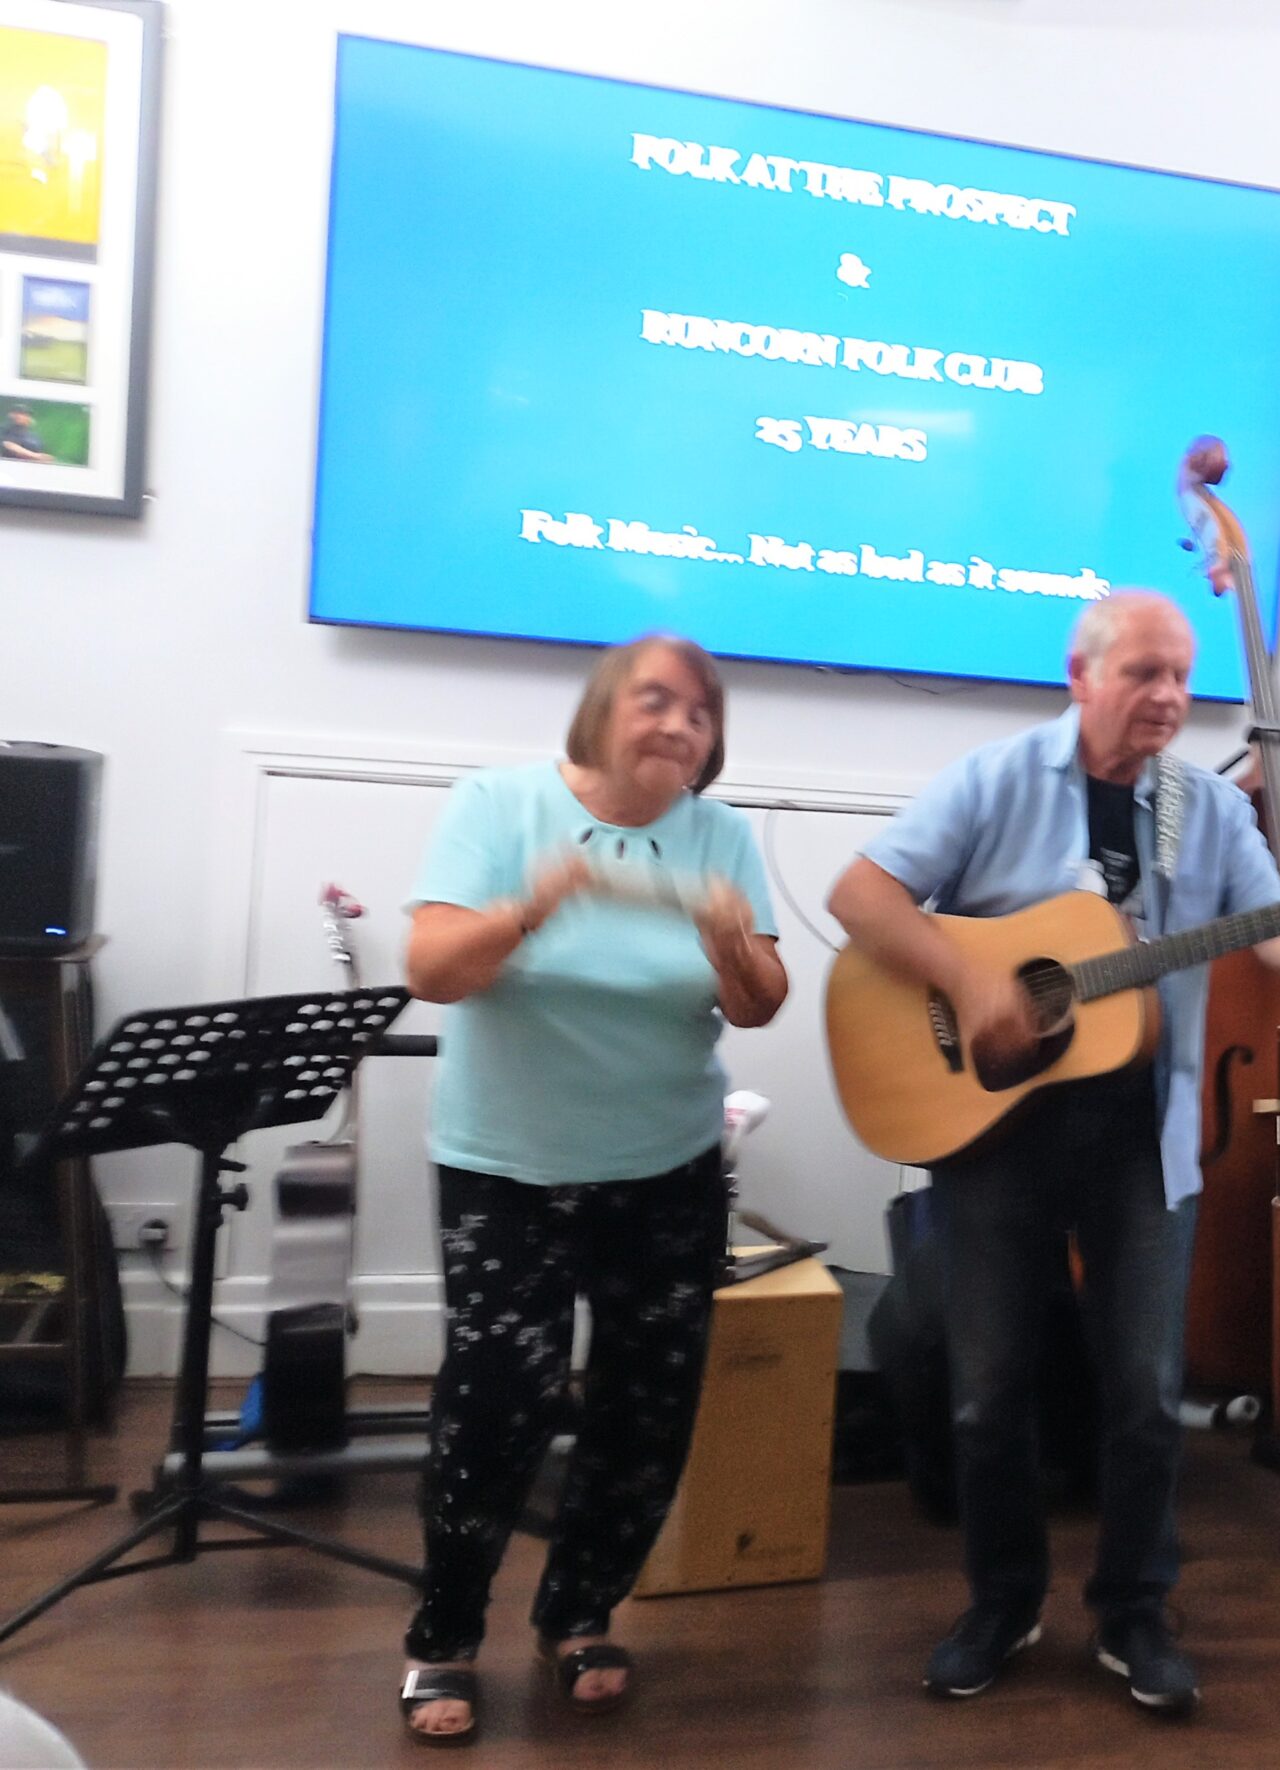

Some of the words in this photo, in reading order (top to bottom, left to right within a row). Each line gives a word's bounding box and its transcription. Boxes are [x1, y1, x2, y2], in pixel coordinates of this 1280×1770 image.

[629, 132, 742, 185] FOLK
[740, 152, 800, 193] AT
[800, 160, 885, 208] THE
[886, 175, 1077, 237] PROSPECT
[837, 252, 872, 289] &
[640, 309, 839, 368] RUNCORN
[840, 337, 945, 383] FOLK
[944, 351, 1045, 395] CLUB
[755, 416, 802, 453] 25
[803, 415, 927, 462] YEARS
[519, 509, 605, 550] Folk
[747, 533, 817, 572] Not
[817, 549, 858, 576] as
[859, 544, 925, 583] bad
[925, 560, 966, 587] as
[967, 555, 998, 591] it
[997, 567, 1111, 601] sounds
